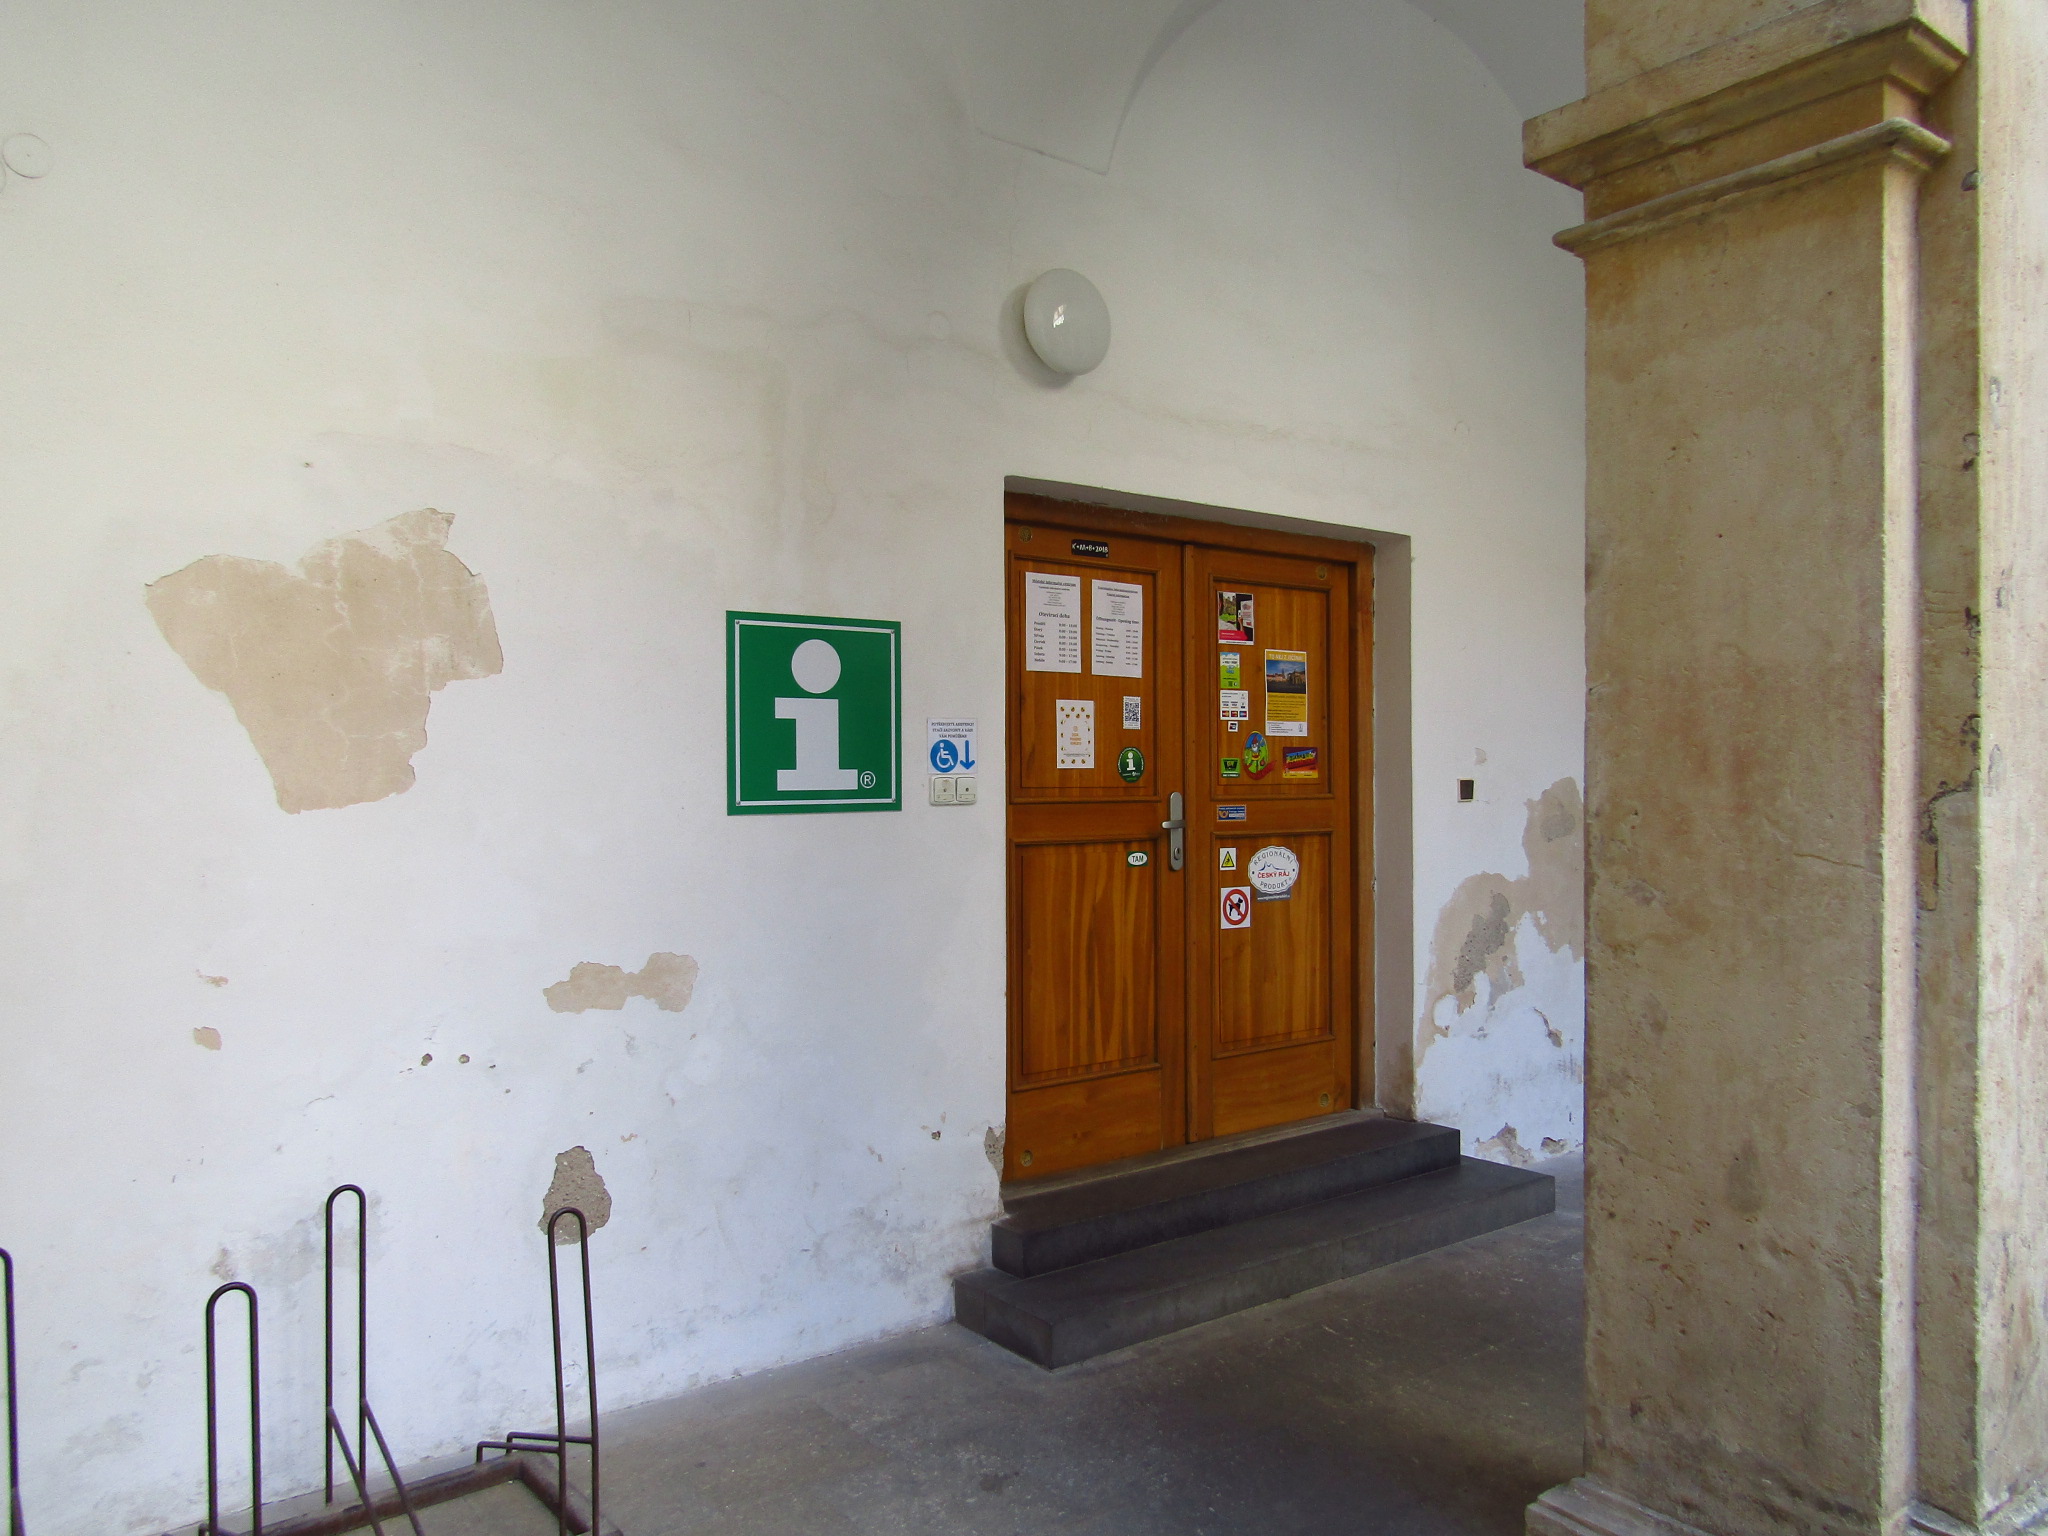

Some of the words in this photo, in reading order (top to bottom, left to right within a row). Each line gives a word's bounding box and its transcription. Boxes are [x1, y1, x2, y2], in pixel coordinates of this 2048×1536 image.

[1257, 870, 1278, 879] ČESKÝ
[1278, 870, 1290, 878] RÁJ
[1259, 879, 1289, 890] PRODUKT
